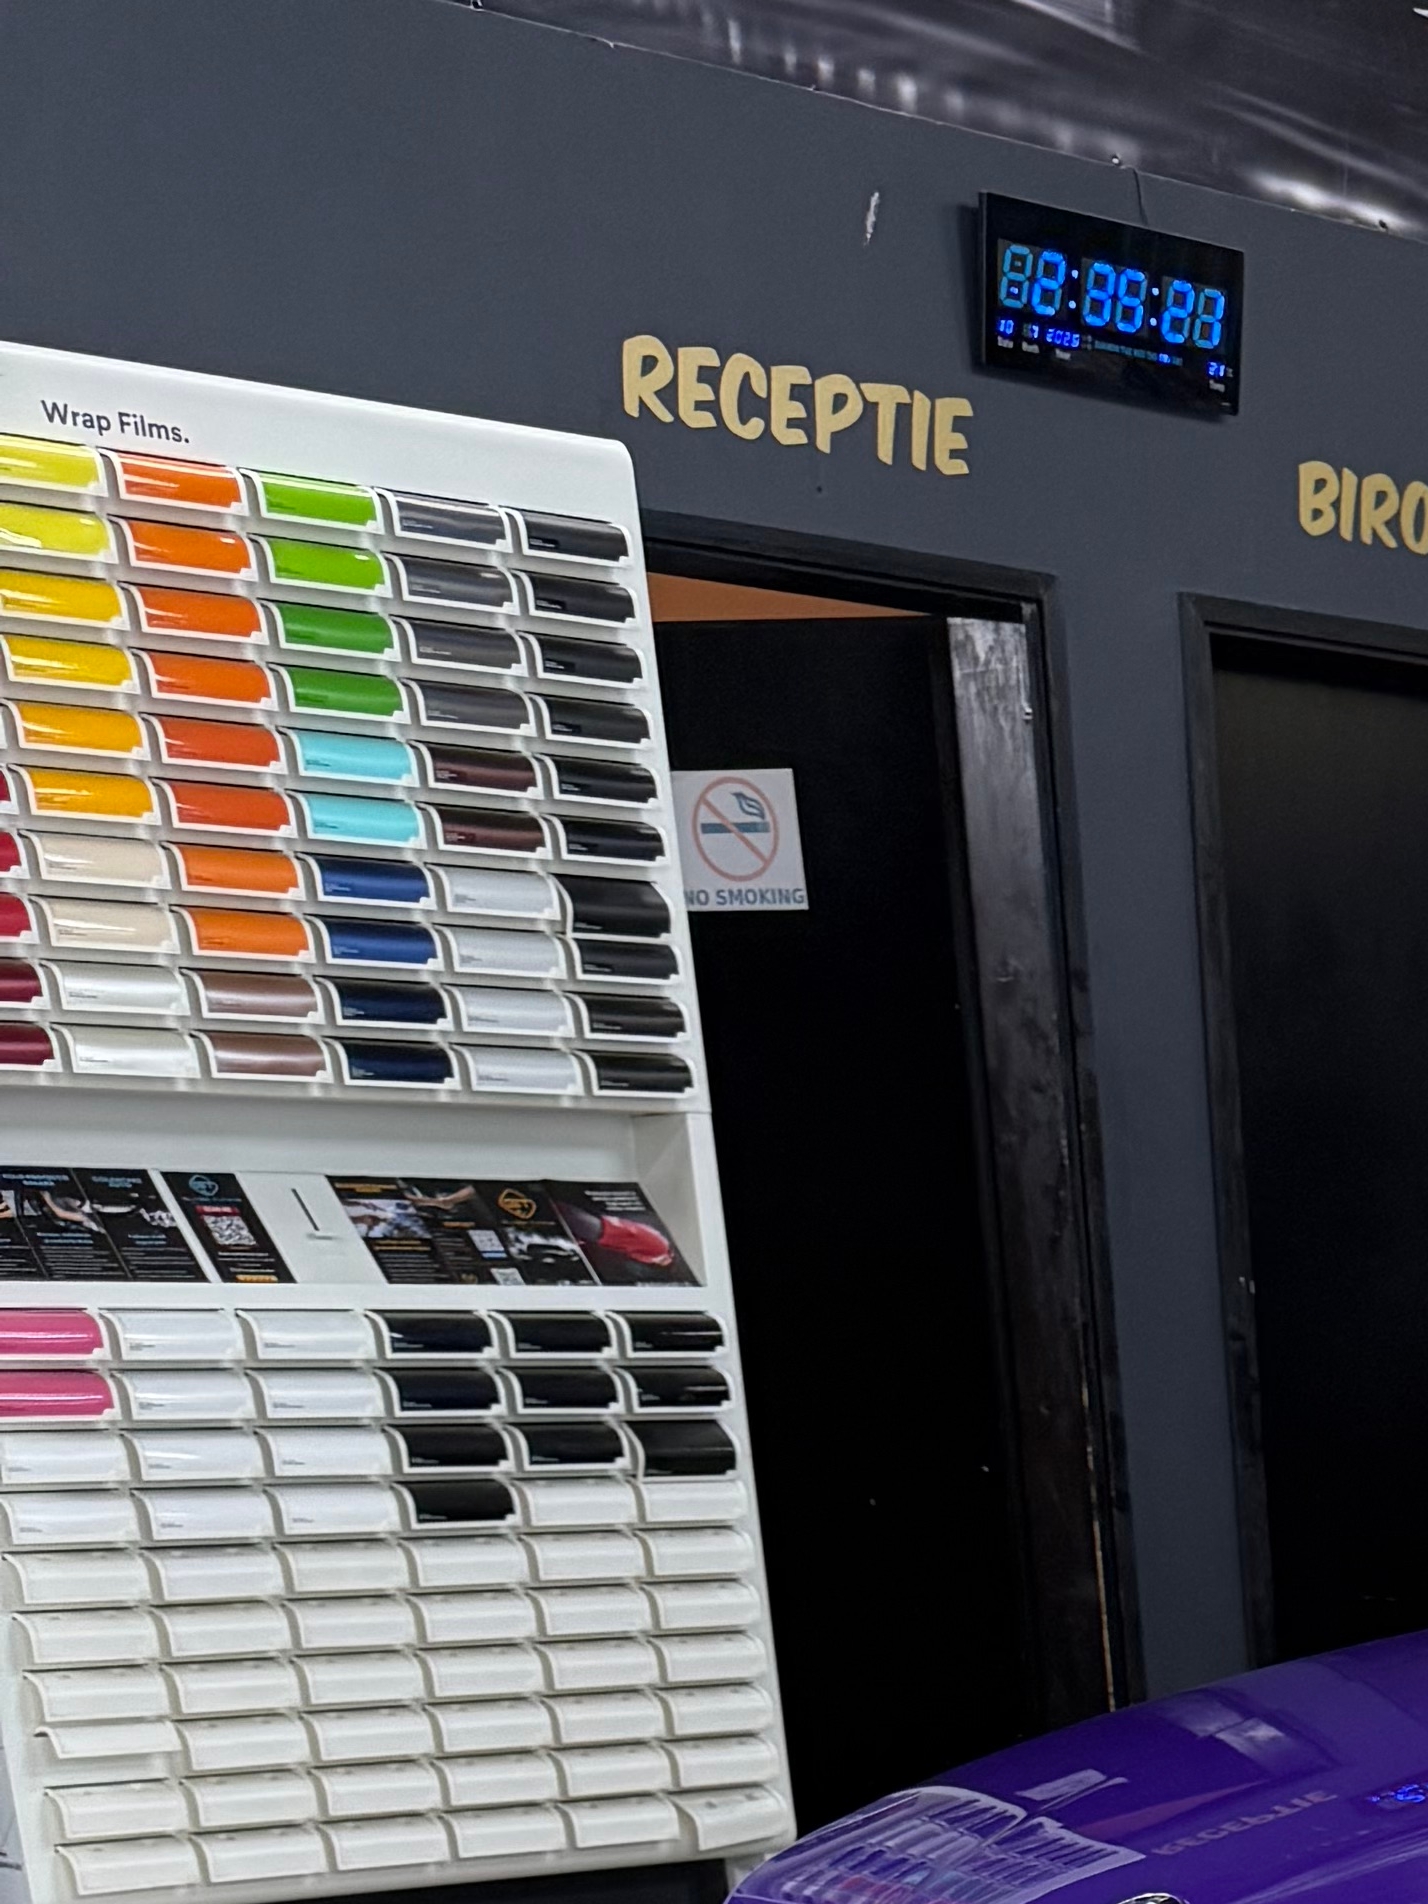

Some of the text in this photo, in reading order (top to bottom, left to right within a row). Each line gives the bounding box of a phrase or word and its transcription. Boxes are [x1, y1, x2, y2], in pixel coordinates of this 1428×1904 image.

[41, 400, 190, 443] Wrap Films.
[622, 335, 974, 476] RECEPTIE
[716, 887, 805, 906] SMOKING
